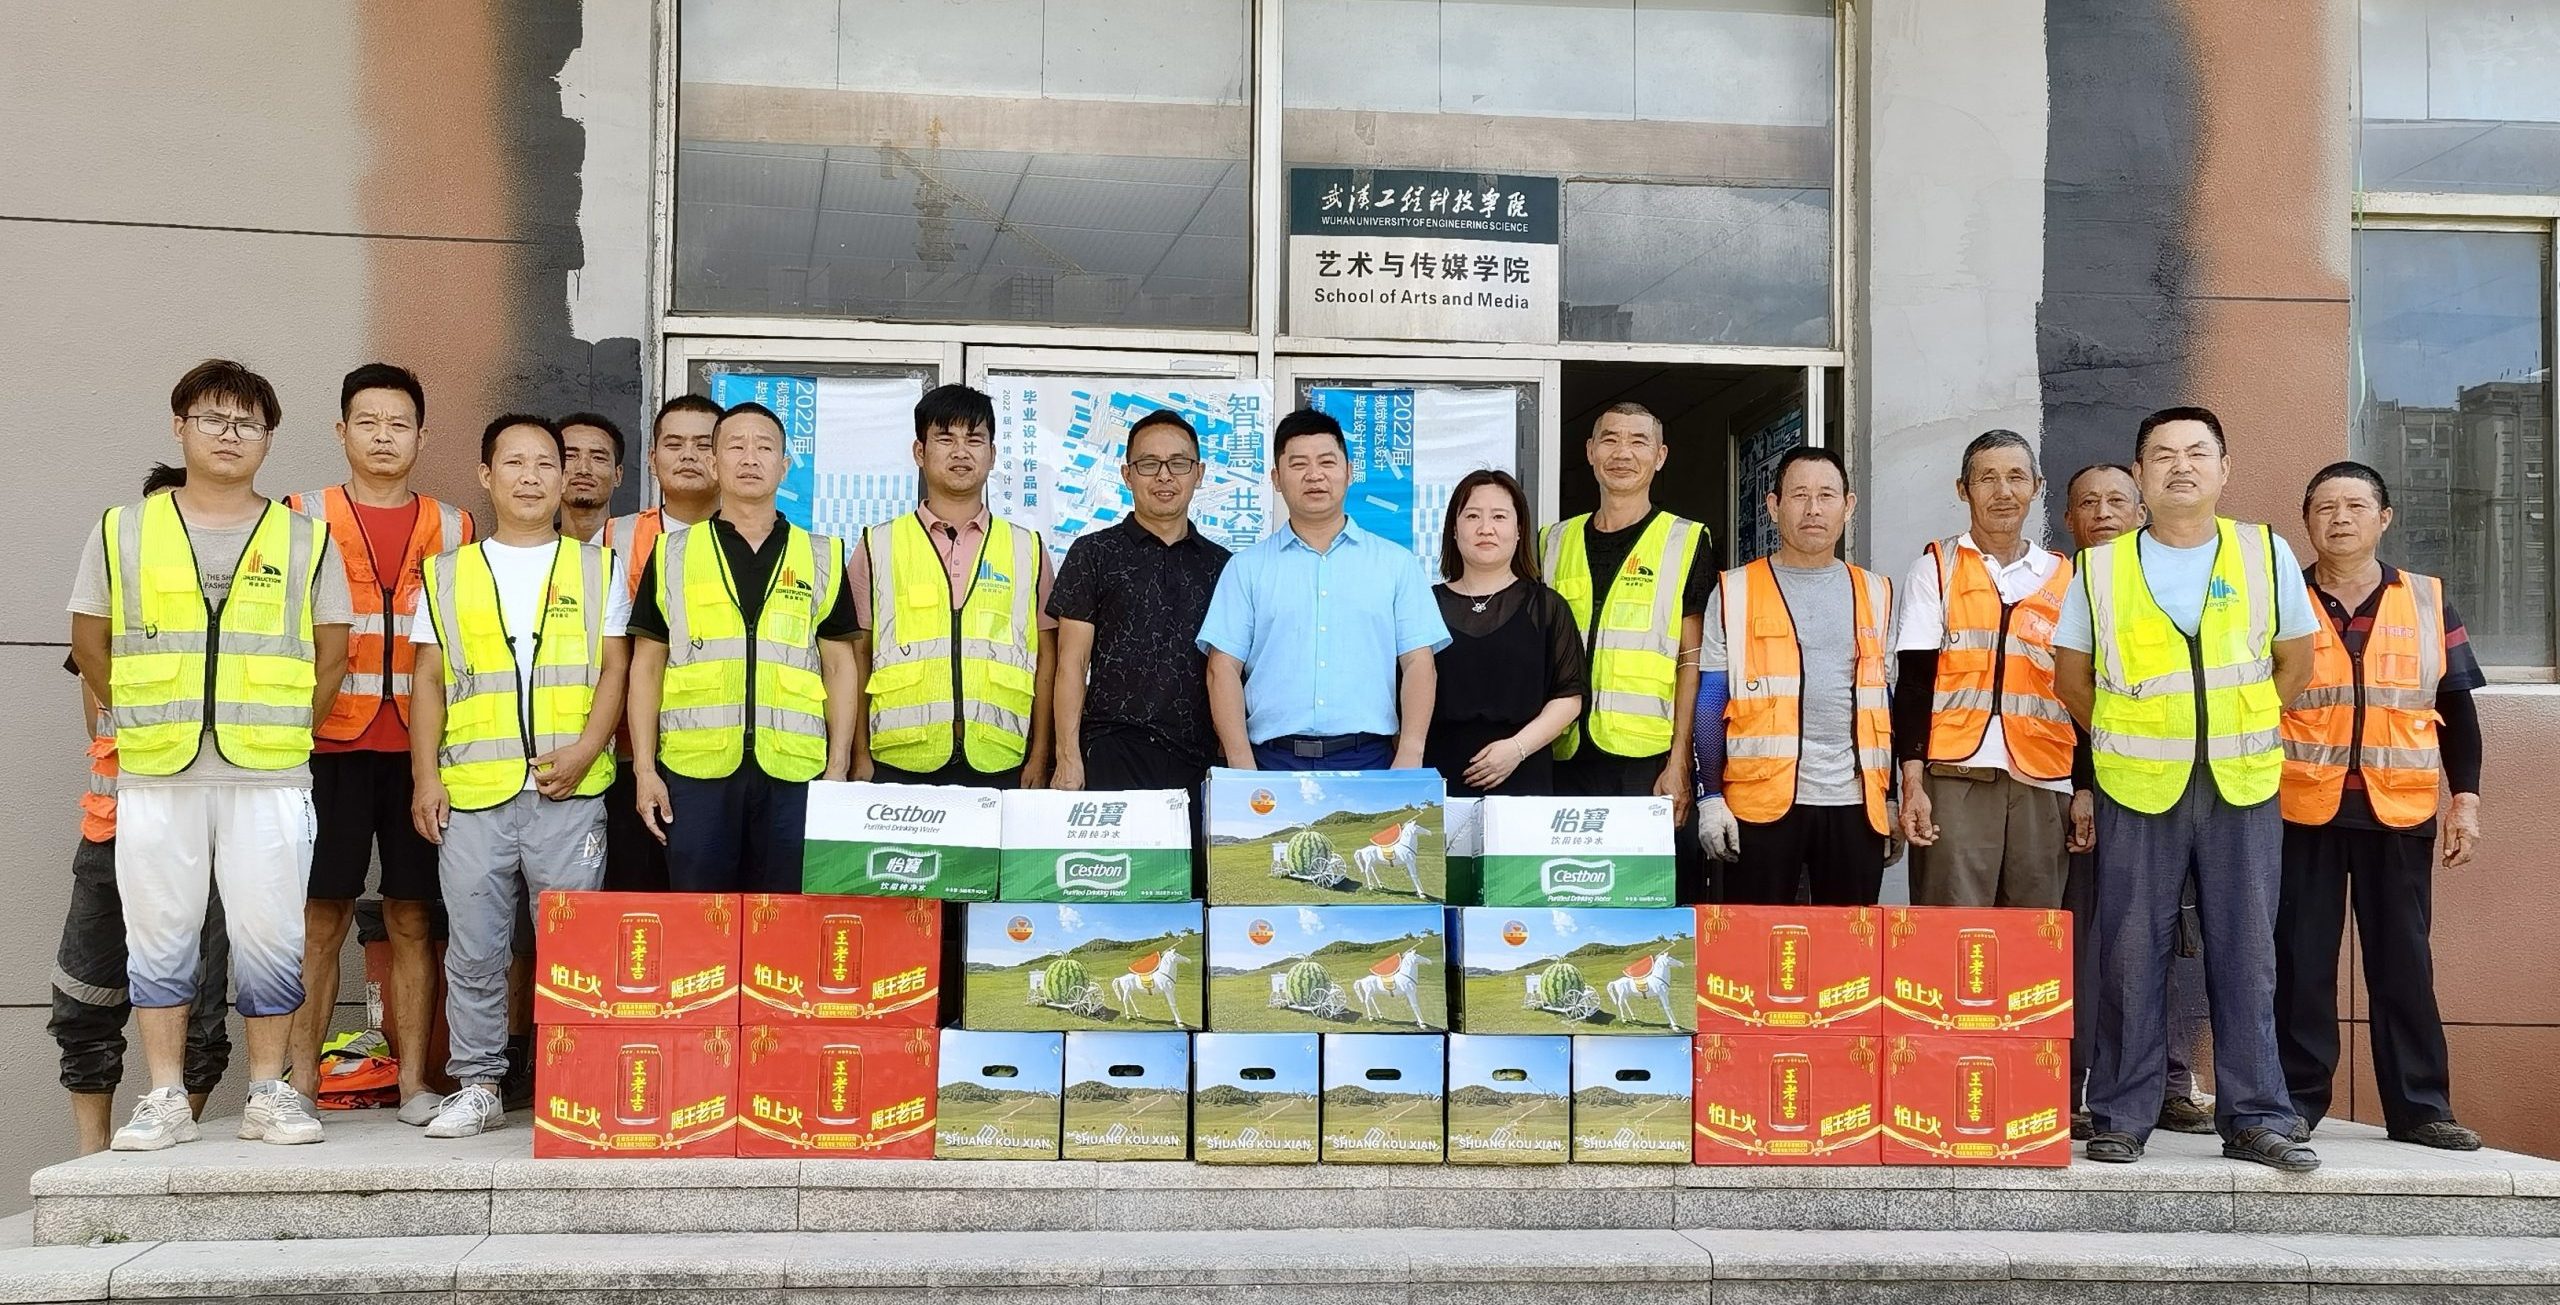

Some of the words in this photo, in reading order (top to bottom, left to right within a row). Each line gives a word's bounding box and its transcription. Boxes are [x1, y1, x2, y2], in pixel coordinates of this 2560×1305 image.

[1321, 216, 1355, 225] WUHAN
[1356, 217, 1412, 227] UNIVERSITY
[1412, 218, 1425, 227] OF
[1426, 218, 1488, 230] ENGINEERING
[1489, 221, 1529, 232] SCIENCE
[1315, 250, 1531, 284] 艺术与传媒学院
[1314, 288, 1374, 304] School
[1380, 289, 1396, 304] of
[1401, 290, 1437, 305] Arts
[1442, 291, 1473, 307] and
[1478, 292, 1529, 309] Media
[793, 381, 815, 454] 2022届
[1374, 394, 1388, 471] 视觉传达设计
[1392, 395, 1412, 466] 2022届
[1022, 389, 1038, 507] 毕业设计作品展
[1352, 394, 1367, 483] 毕业设计作品展
[1067, 801, 1128, 827] 怡寶
[1551, 807, 1610, 833] 怡寶
[1067, 829, 1121, 839] 饮用纯净水
[631, 928, 647, 980] 王老吉
[832, 929, 849, 981] 王老吉
[1781, 940, 1797, 991] 王老吉
[1968, 943, 1985, 994] 王老吉
[551, 963, 602, 998] 怕上火
[671, 964, 726, 1000] 喝王老吉
[755, 963, 805, 998] 怕上火
[871, 966, 927, 1001] 喝王老吉
[1707, 973, 1755, 1007] 怕上火
[1818, 976, 1871, 1010] 喝王老吉
[1895, 976, 1944, 1011] 怕上火
[2008, 979, 2061, 1013] 喝王老吉
[630, 1060, 647, 1112] 王老吉
[831, 1060, 848, 1112] 王老吉
[1782, 1068, 1798, 1119] 王老吉
[1967, 1071, 1984, 1122] 王老吉
[550, 1095, 601, 1130] 怕上火
[671, 1095, 727, 1131] 喝王老吉
[753, 1094, 803, 1130] 怕上火
[871, 1097, 926, 1132] 喝王老吉
[1708, 1102, 1757, 1136] 怕上火
[1820, 1103, 1872, 1138] 喝王老吉
[1894, 1104, 1942, 1139] 怕上火
[2006, 1107, 2058, 1141] 喝王老吉
[945, 1136, 993, 1146] SHUANG
[995, 1137, 1020, 1147] KOU
[1021, 1138, 1051, 1149] XIAN
[1075, 1134, 1122, 1145] SHUANG
[1125, 1135, 1150, 1145] KOU
[1152, 1135, 1180, 1146] XIAN
[1207, 1139, 1254, 1149] SHUANG
[1257, 1140, 1281, 1149] KOU
[1284, 1140, 1312, 1150] XIAN
[1333, 1138, 1379, 1149] SHUANG
[1382, 1139, 1407, 1149] KOU
[1409, 1140, 1436, 1151] XIAN
[1458, 1139, 1506, 1149] SHUANG
[1508, 1140, 1532, 1149] KOU
[1535, 1140, 1562, 1150] XIAN
[1583, 1139, 1630, 1149] SHUANG
[1633, 1140, 1656, 1149] KOU
[1658, 1140, 1685, 1151] XIAN
